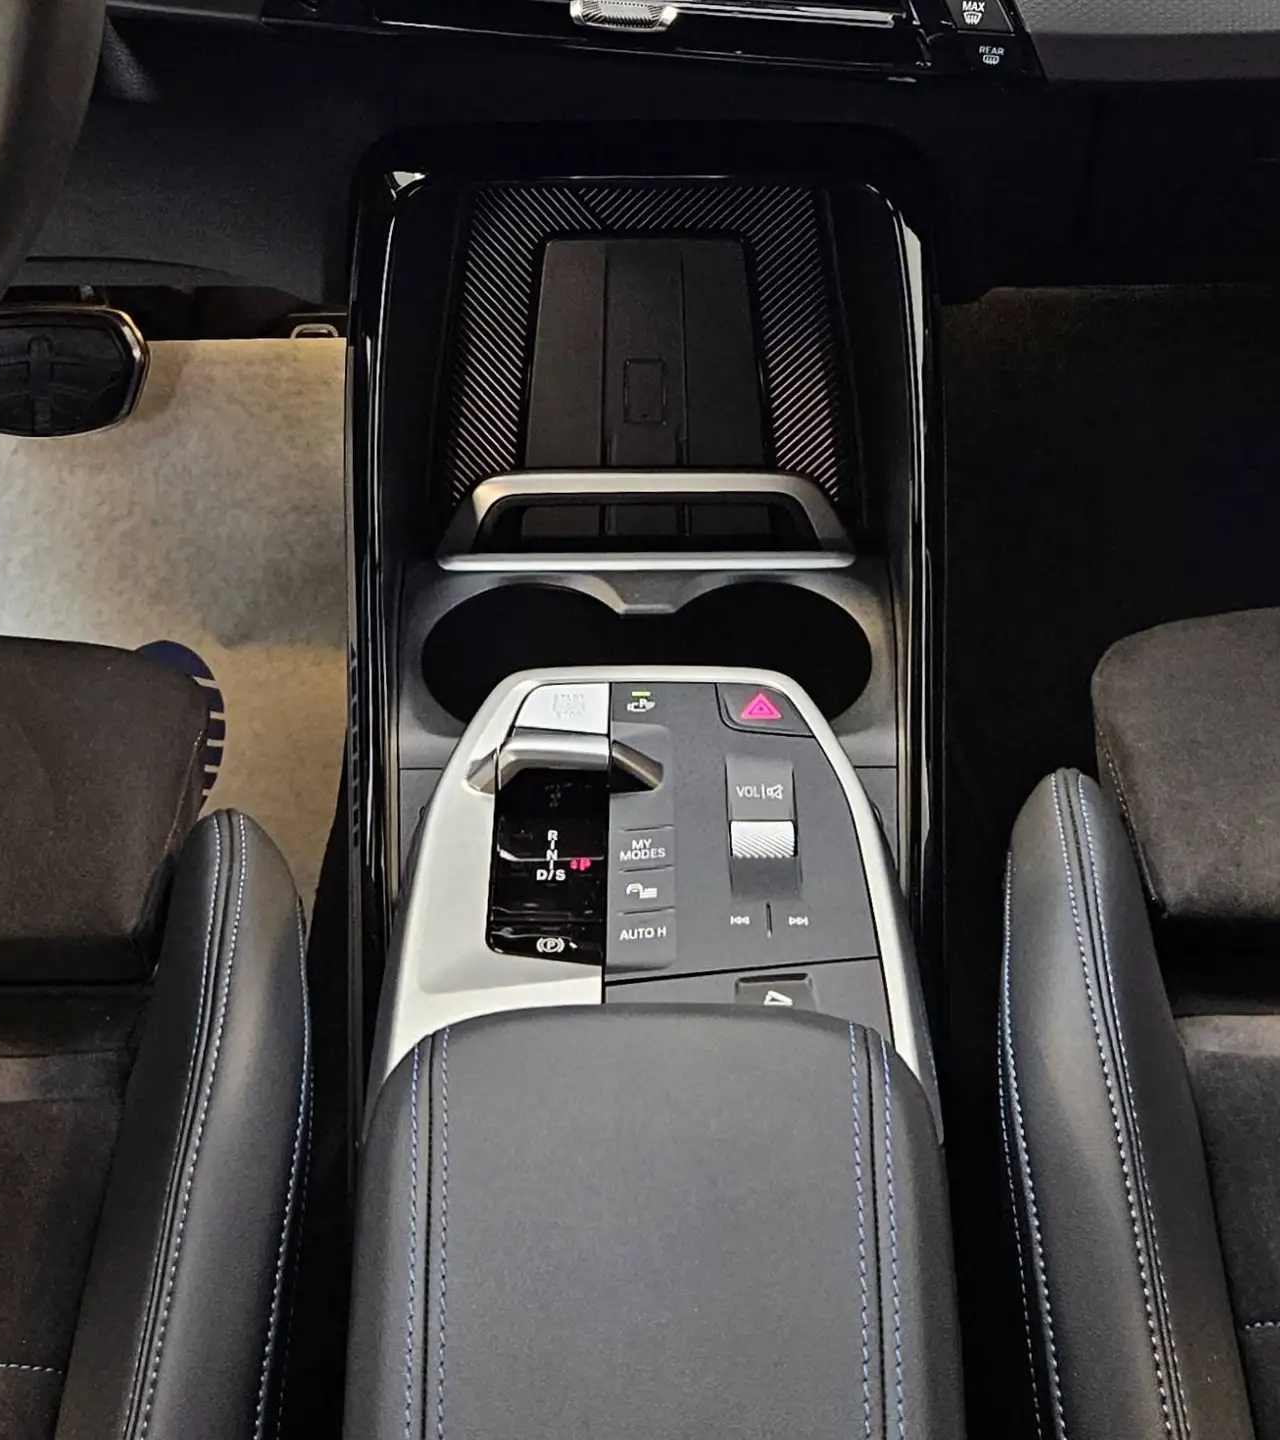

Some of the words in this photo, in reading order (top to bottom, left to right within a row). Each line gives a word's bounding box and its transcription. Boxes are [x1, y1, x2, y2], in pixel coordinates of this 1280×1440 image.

[962, 0, 985, 12] MAX
[979, 45, 1005, 56] REAR
[736, 785, 760, 798] VOL
[547, 830, 558, 841] R
[631, 839, 652, 849] MY
[546, 850, 558, 860] N
[620, 849, 666, 861] MODES
[536, 869, 566, 881] D/S
[620, 927, 654, 940] AUTO
[657, 926, 667, 936] H
